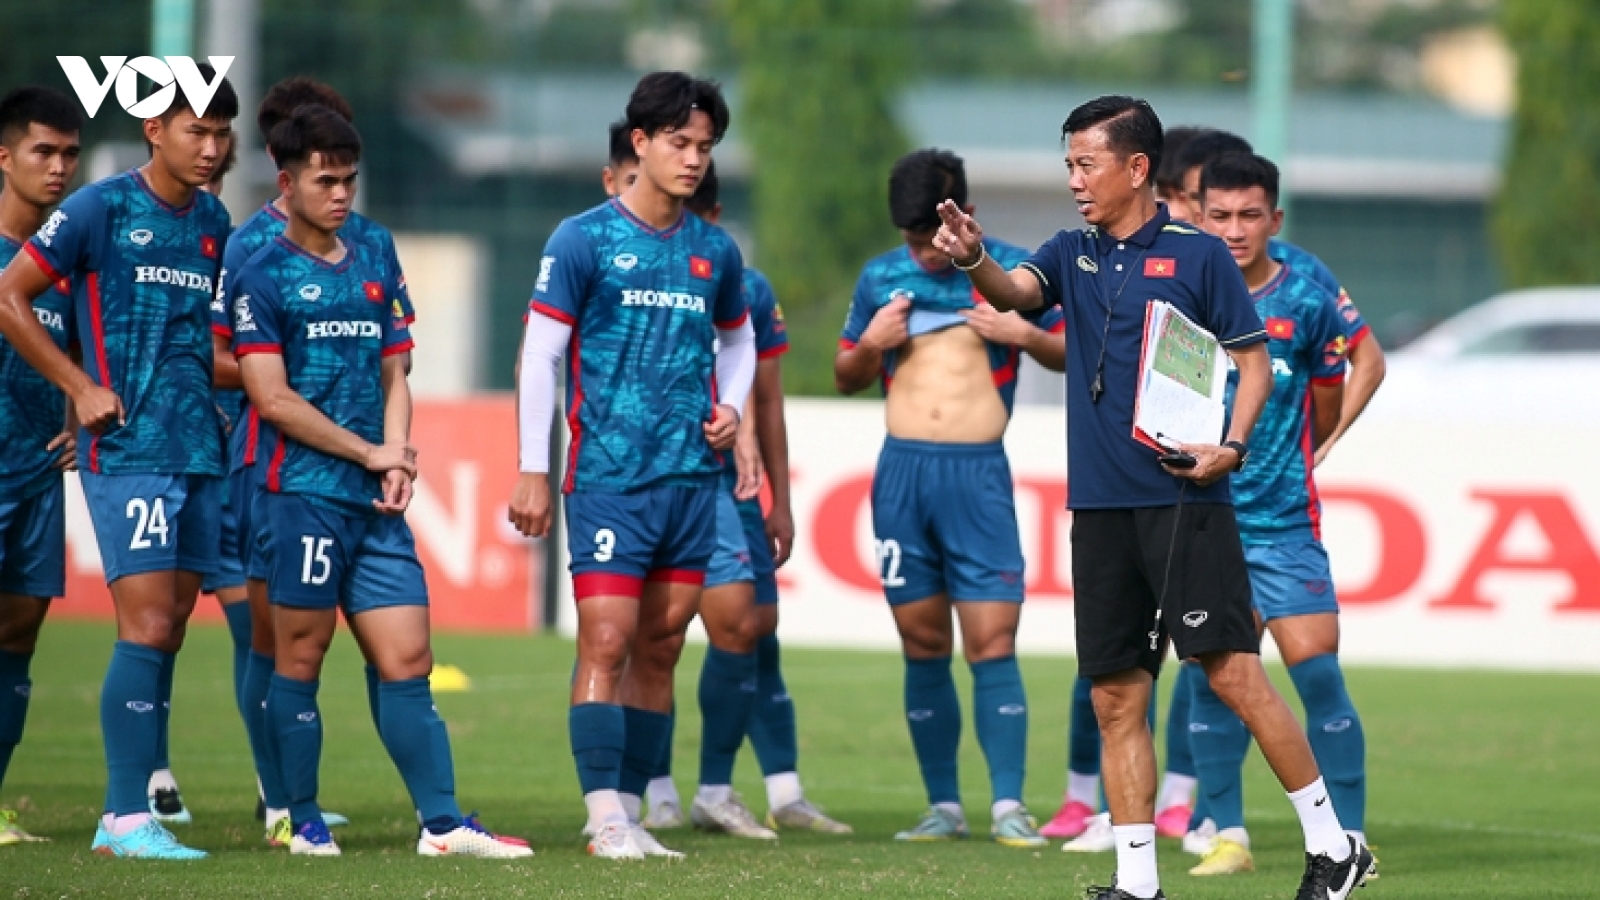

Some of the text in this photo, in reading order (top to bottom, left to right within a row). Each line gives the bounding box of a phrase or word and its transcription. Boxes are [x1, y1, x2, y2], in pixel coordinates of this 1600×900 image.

[135, 266, 212, 293] HONDA
[621, 290, 705, 313] HONDA
[126, 498, 168, 550] 24
[301, 535, 333, 584] 15
[593, 528, 616, 562] 3
